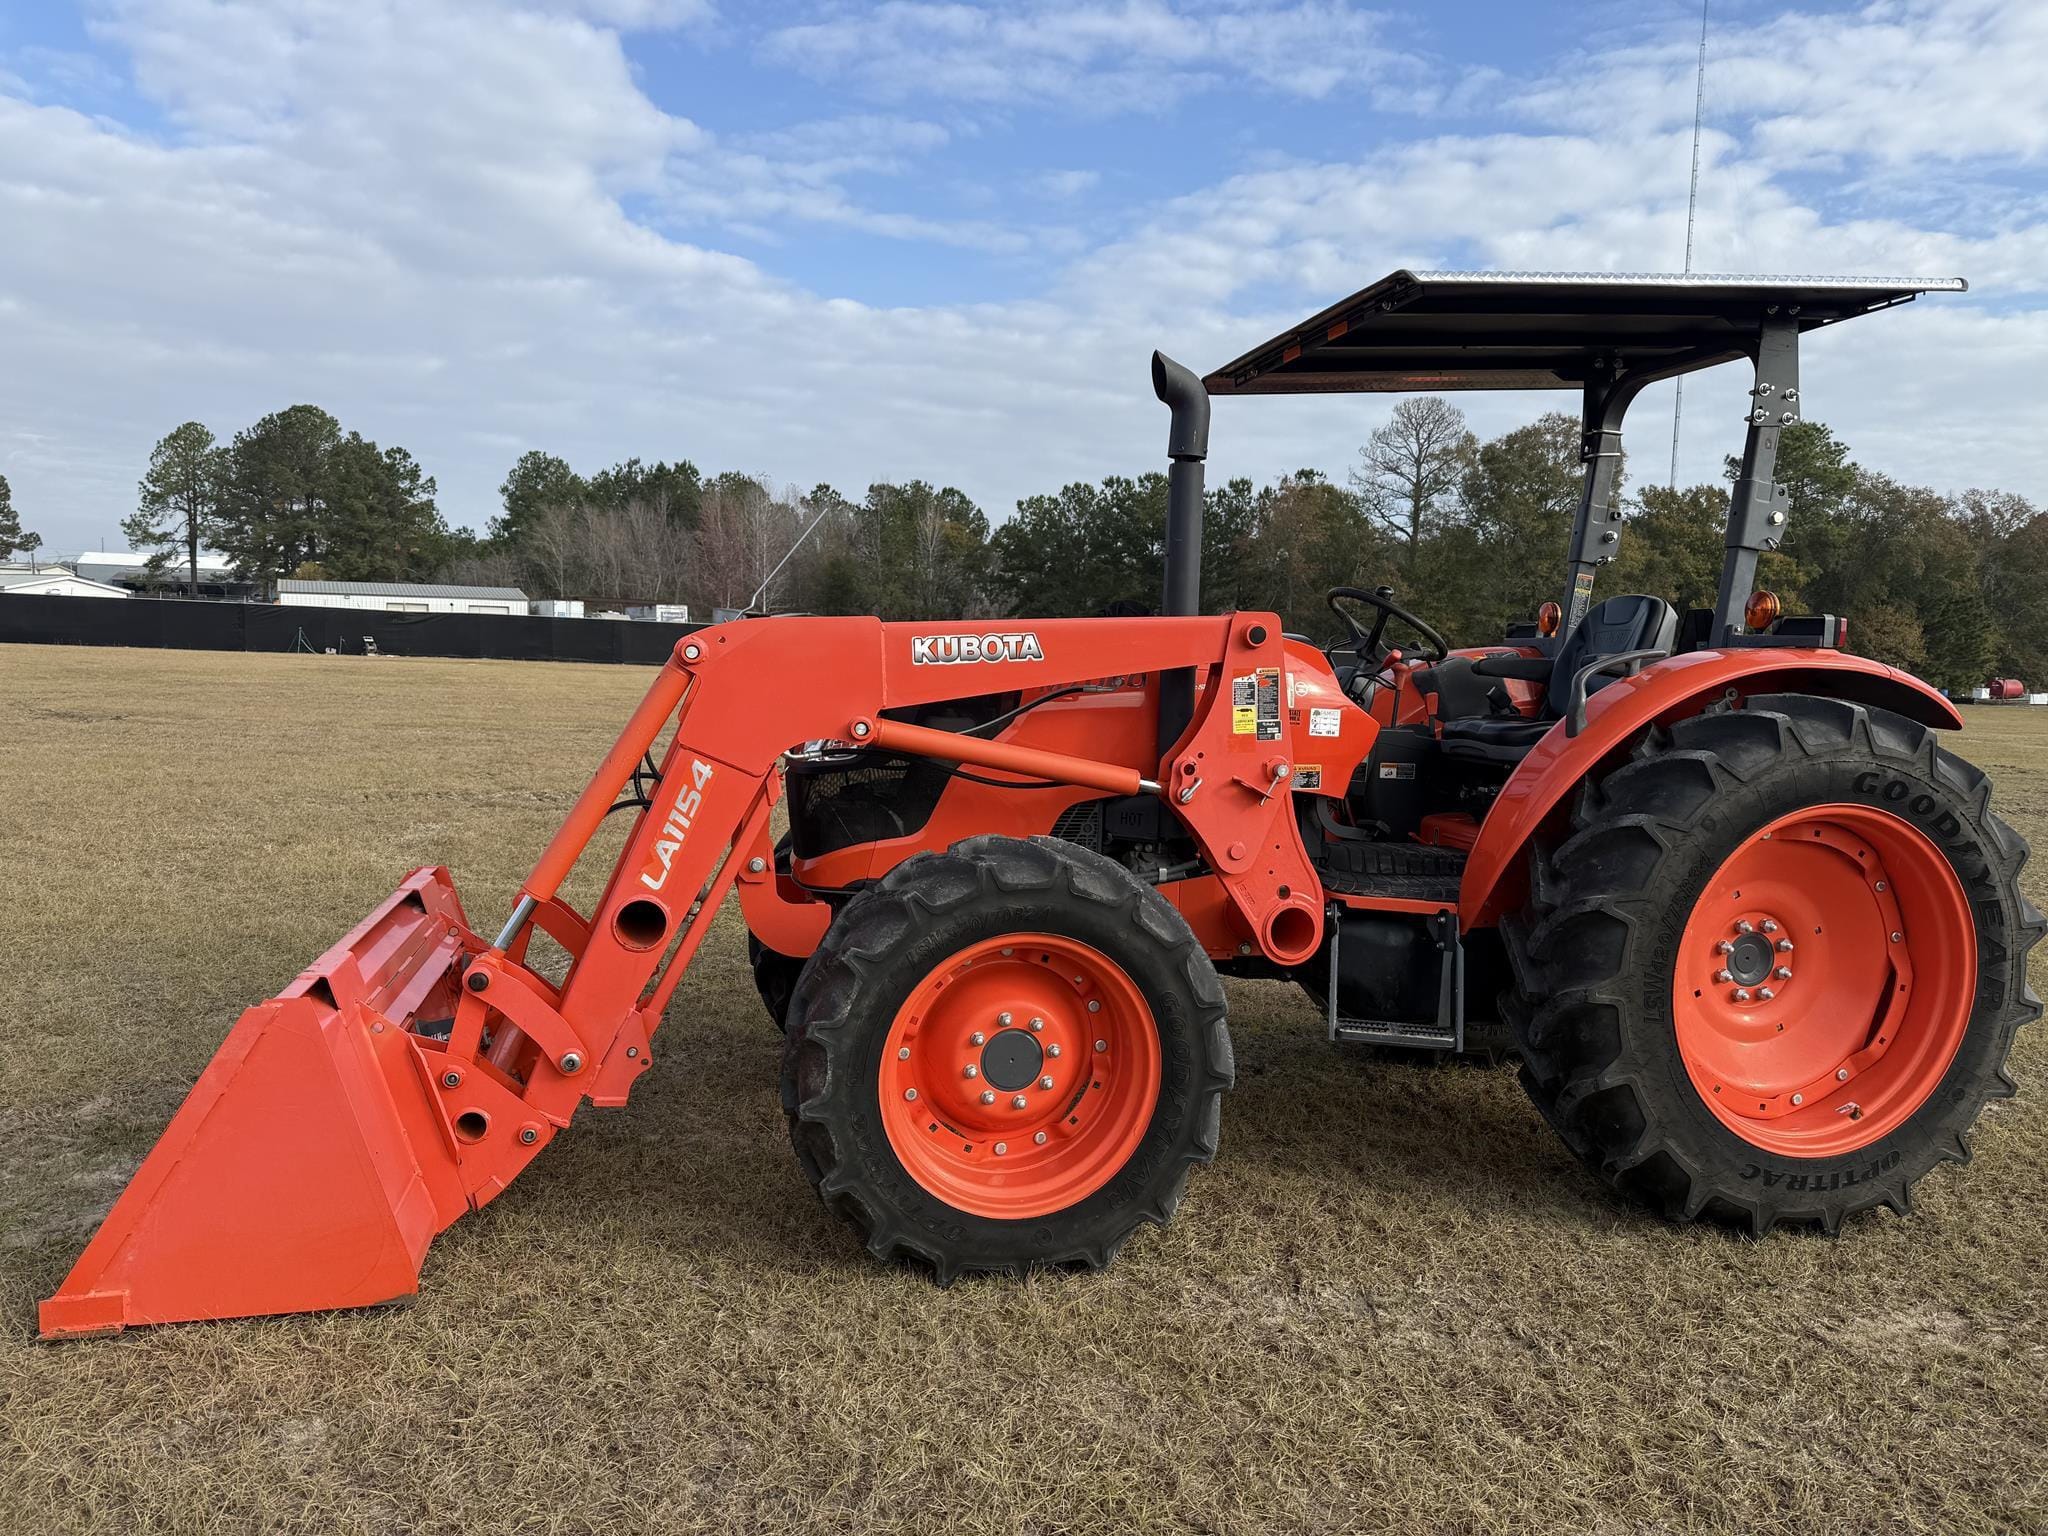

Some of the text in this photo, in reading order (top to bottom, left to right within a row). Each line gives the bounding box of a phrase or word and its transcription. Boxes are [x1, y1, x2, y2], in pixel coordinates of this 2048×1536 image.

[912, 633, 1044, 665] KUBOTA
[640, 758, 713, 890] LA1154
[1120, 812, 1144, 828] HOT
